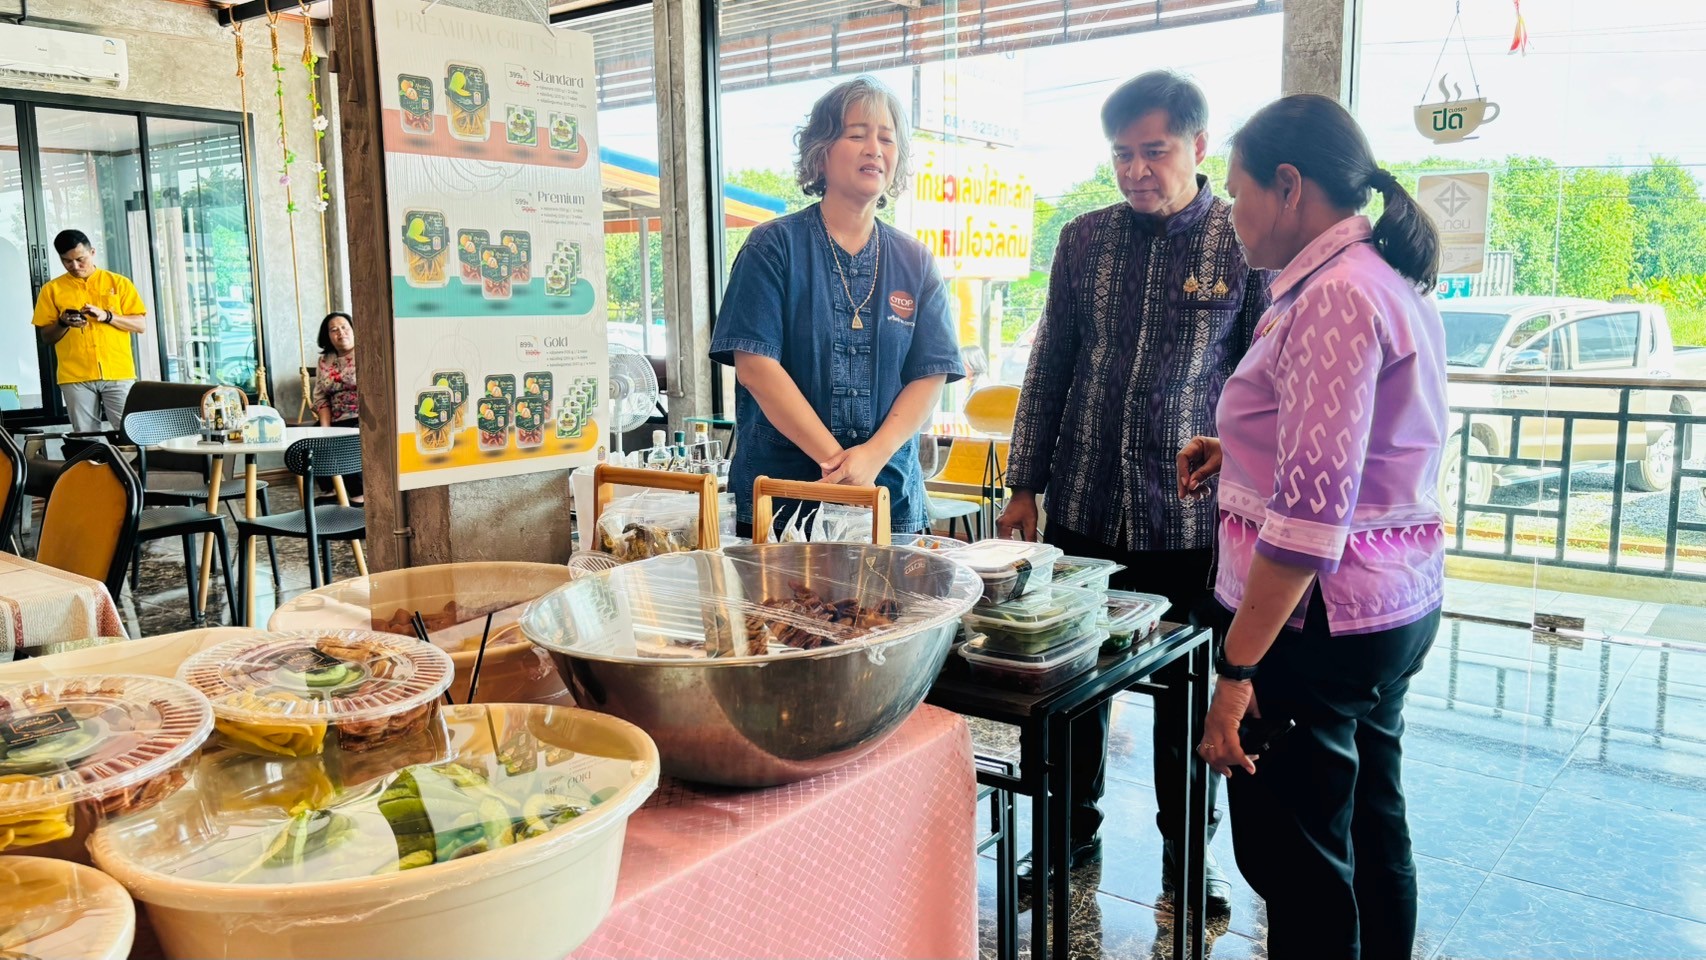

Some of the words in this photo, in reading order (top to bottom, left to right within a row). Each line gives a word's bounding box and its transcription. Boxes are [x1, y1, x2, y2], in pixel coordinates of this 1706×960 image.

[395, 8, 491, 45] PREMIUM
[496, 29, 537, 53] GIFT
[541, 36, 576, 59] SET
[532, 69, 584, 88] Standard
[1432, 107, 1463, 131] ปิด
[537, 190, 585, 205] Premium
[890, 295, 914, 307] OTOP
[543, 336, 569, 348] Gold
